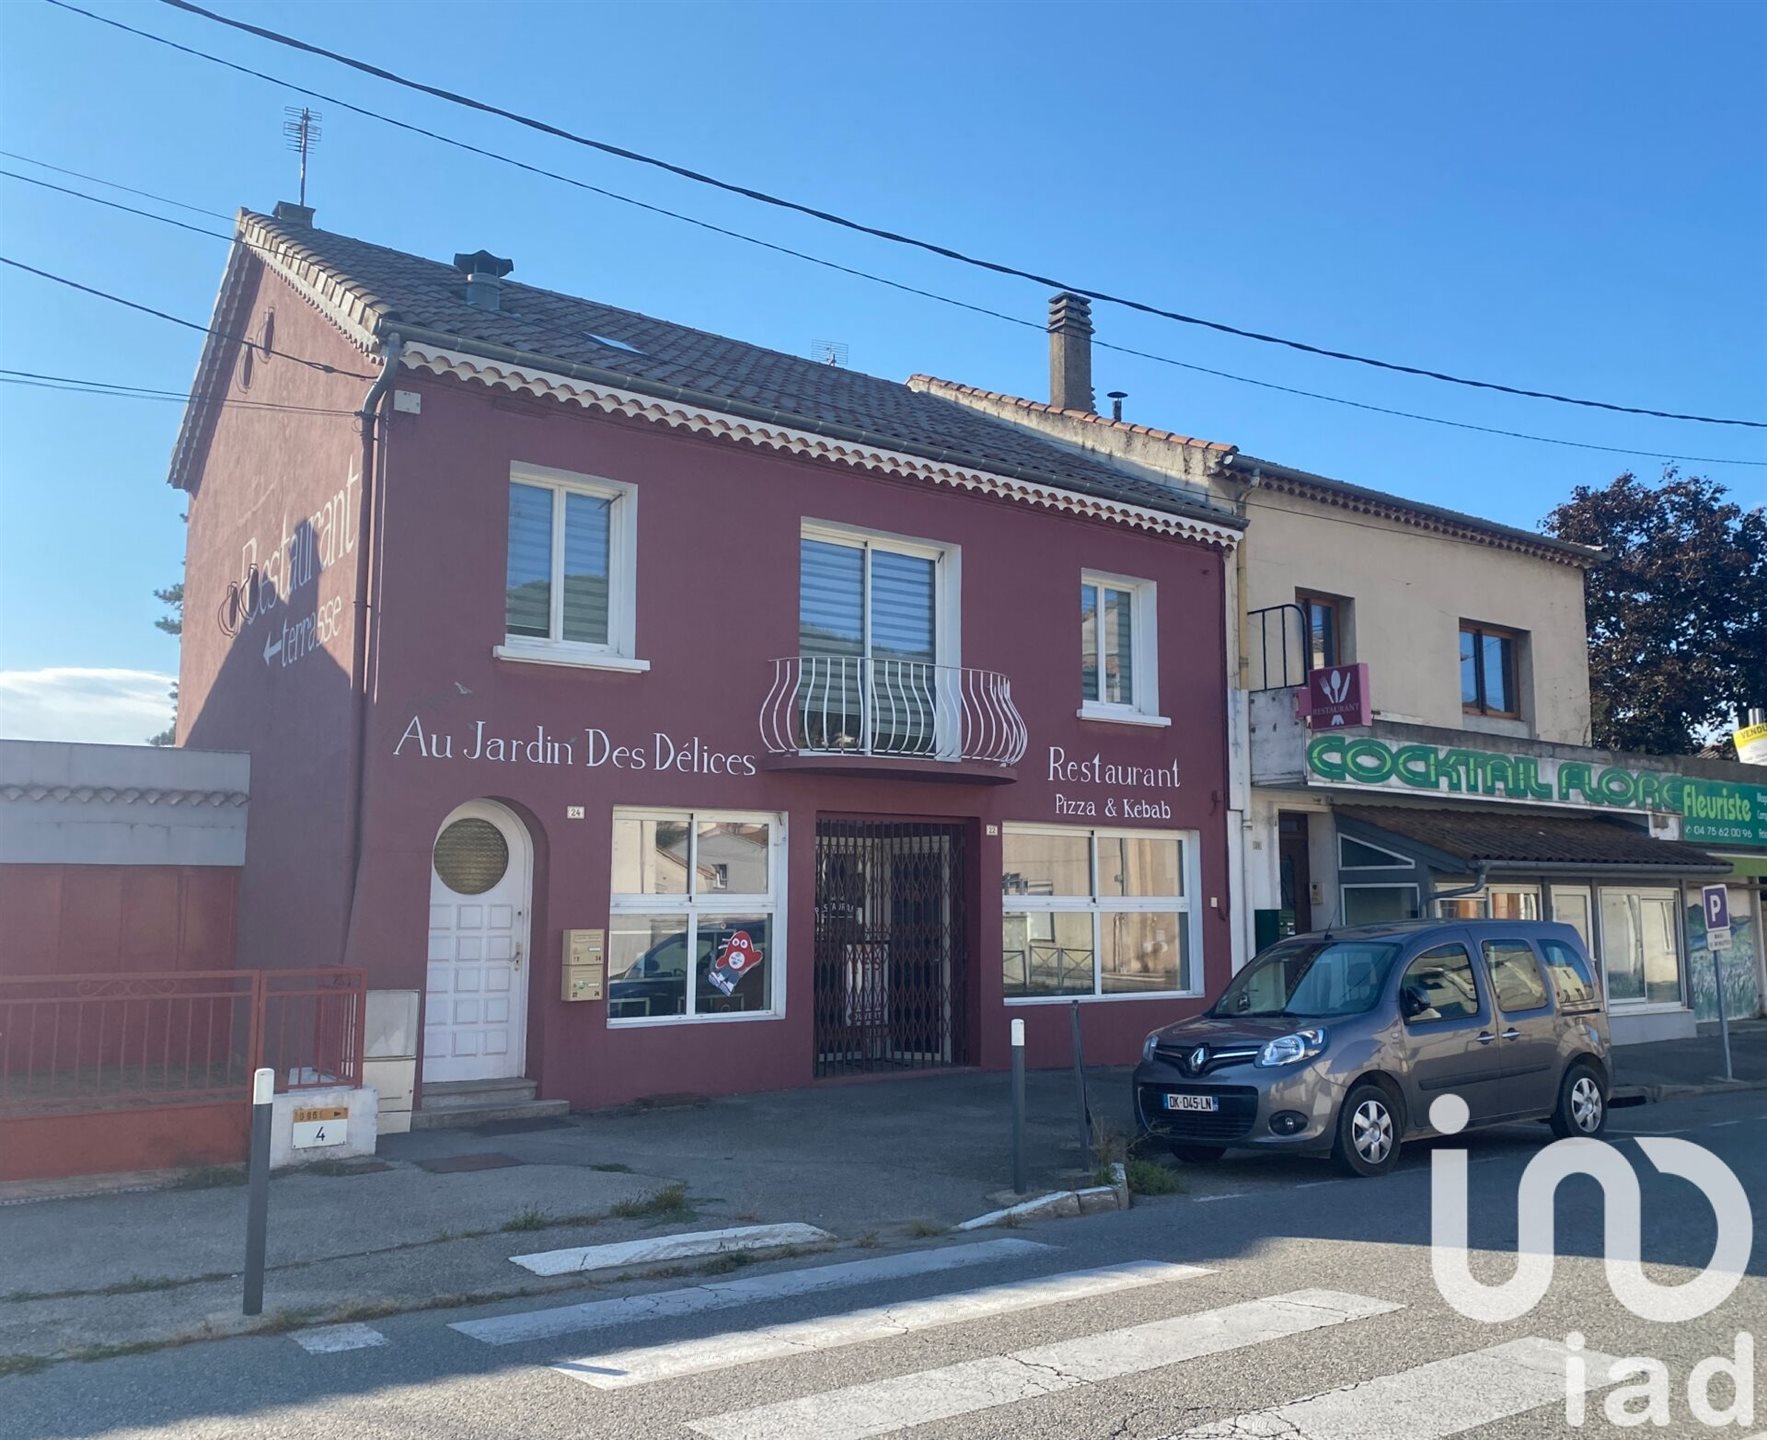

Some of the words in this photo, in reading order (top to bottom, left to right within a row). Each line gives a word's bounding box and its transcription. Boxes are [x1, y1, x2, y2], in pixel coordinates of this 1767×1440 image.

[238, 453, 360, 625] Restaurant
[281, 595, 343, 668] terrasse
[1312, 702, 1360, 715] RESTAURANT
[393, 715, 453, 759] Au
[463, 720, 573, 766] Jardin
[585, 728, 647, 770] Des
[653, 732, 757, 776] Délices
[1047, 746, 1181, 788] Restaurant
[1307, 735, 1553, 799] COCKTAIL
[569, 807, 581, 817] 24
[1055, 793, 1097, 816] Pizza
[1104, 797, 1118, 817] &
[1123, 798, 1171, 819] Kebab
[1683, 784, 1752, 822] Fleuriste
[1693, 825, 1705, 835] 04
[1707, 826, 1717, 836] 75
[1718, 827, 1730, 837] 62
[1731, 828, 1741, 837] 00
[1742, 828, 1753, 838] 96
[1710, 895, 1721, 922] P
[315, 1126, 326, 1142] 4
